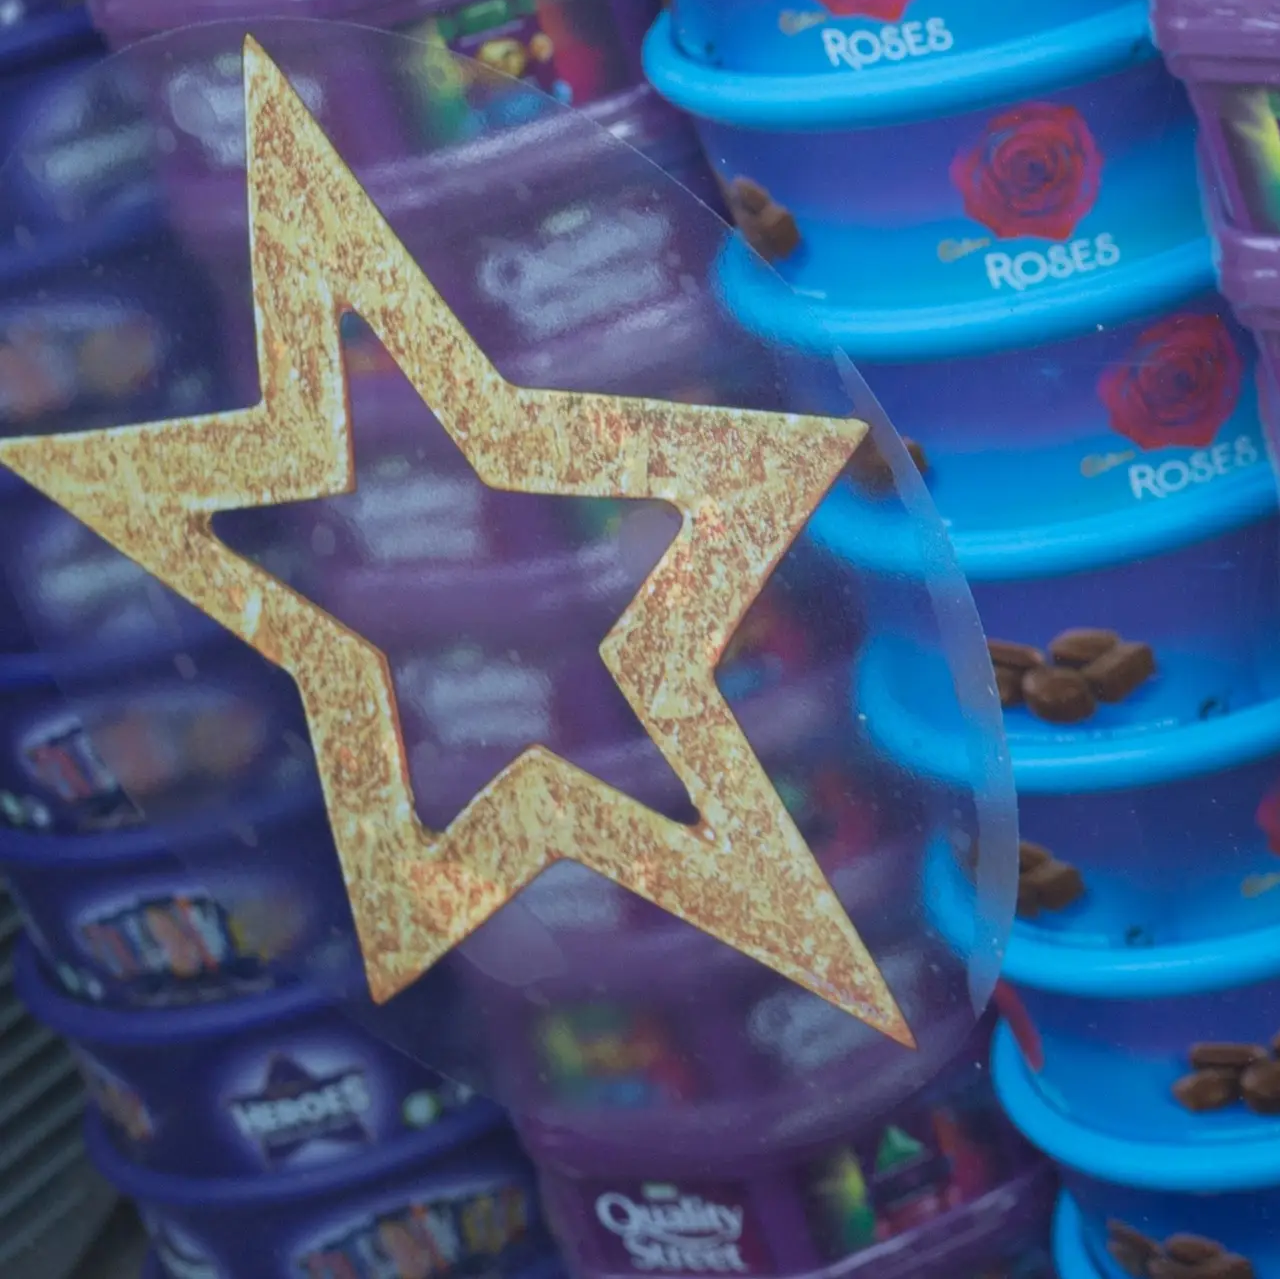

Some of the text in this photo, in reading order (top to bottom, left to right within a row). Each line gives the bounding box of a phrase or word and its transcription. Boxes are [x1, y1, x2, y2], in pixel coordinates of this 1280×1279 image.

[822, 18, 954, 69] ROSES
[983, 234, 1121, 291] ROSES
[1127, 437, 1258, 499] ROSES
